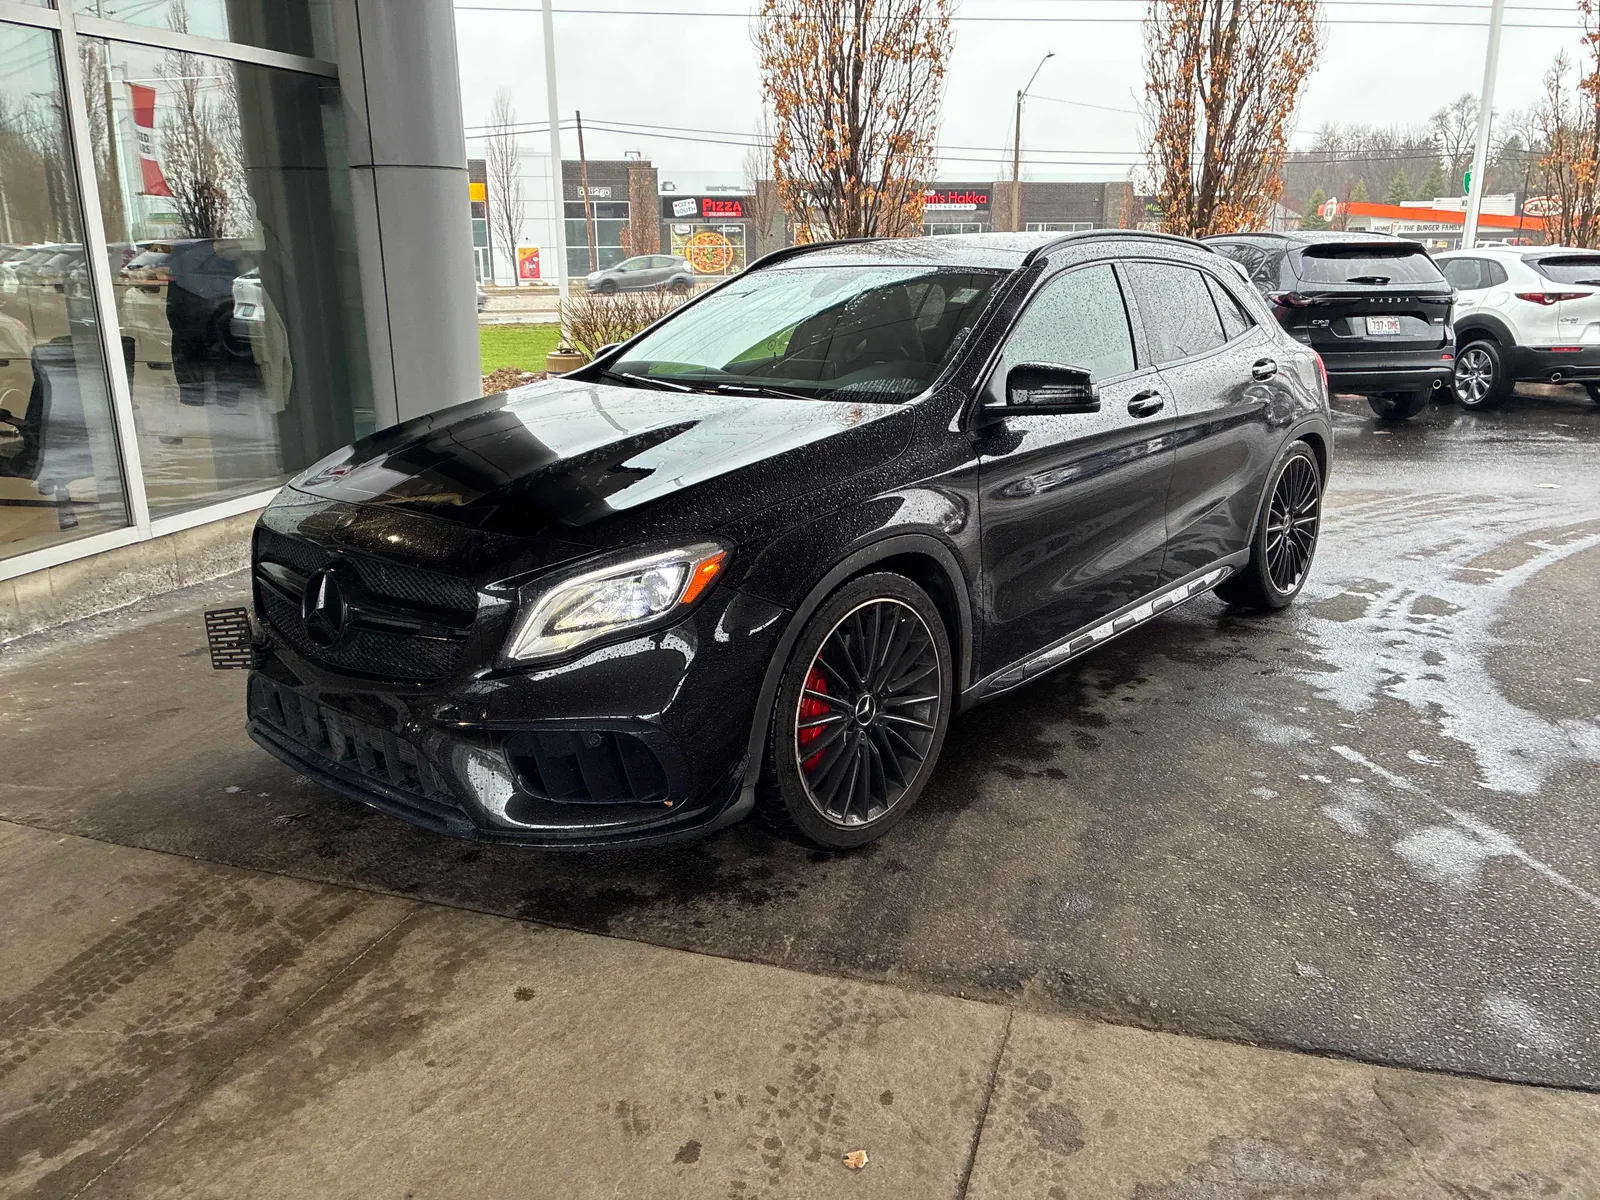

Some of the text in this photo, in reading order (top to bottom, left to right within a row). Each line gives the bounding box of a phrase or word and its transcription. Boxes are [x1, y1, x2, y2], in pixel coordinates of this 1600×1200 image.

[579, 187, 610, 198] dli2go
[948, 191, 988, 204] Hakka
[677, 200, 691, 208] CITY
[702, 198, 742, 212] PIZZA
[675, 207, 696, 215] SOUTH
[1416, 223, 1440, 232] BURGER
